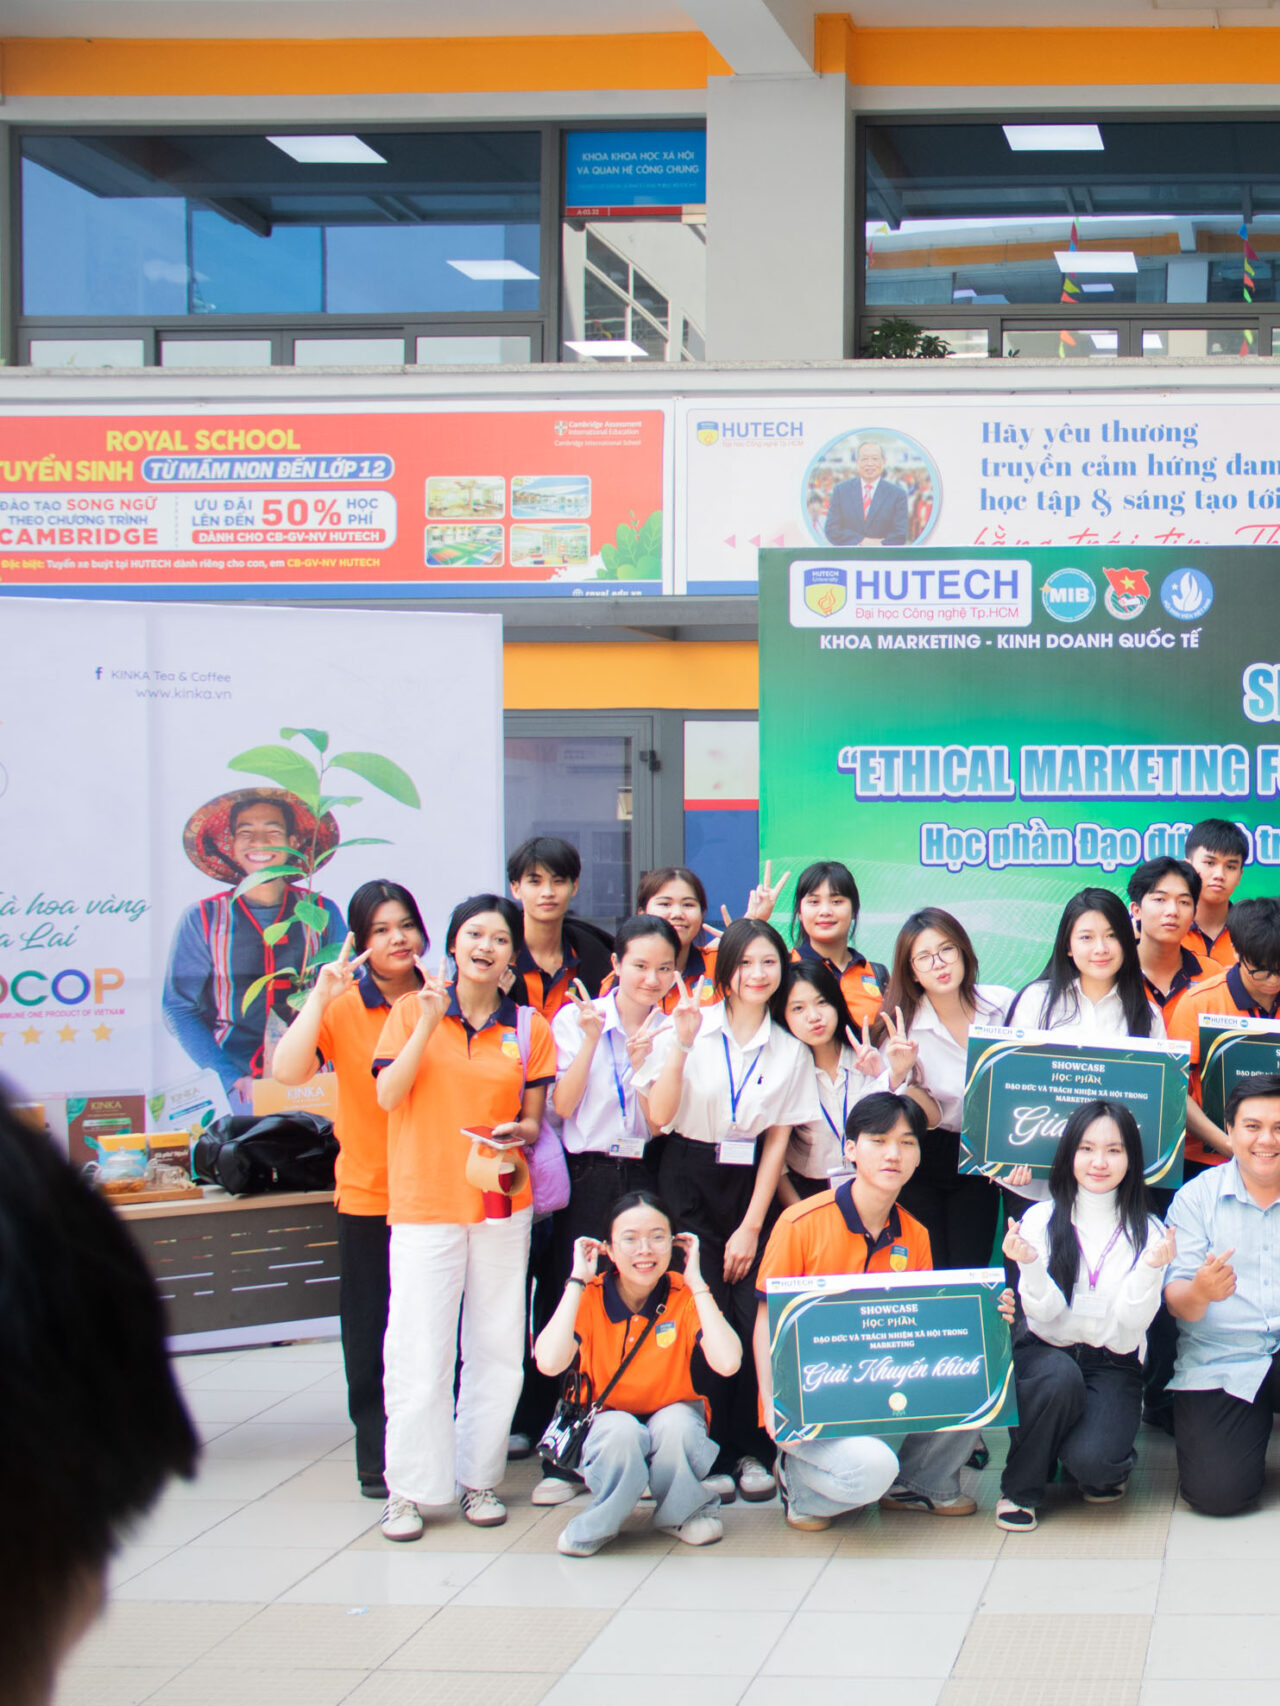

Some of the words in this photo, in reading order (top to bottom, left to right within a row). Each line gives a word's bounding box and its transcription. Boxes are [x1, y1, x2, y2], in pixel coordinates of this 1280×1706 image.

[582, 152, 608, 161] KHOA
[611, 152, 637, 161] KHOA
[722, 421, 803, 438] HUTECH
[981, 422, 1033, 449] Hãy
[1043, 423, 1092, 450] yêu
[1101, 420, 1199, 449] thương
[106, 430, 188, 451] ROYAL
[195, 429, 301, 451] SCHOOL
[76, 460, 133, 482] SINH
[150, 458, 179, 480] TỪ
[179, 458, 233, 480] MẦM
[233, 461, 276, 479] NON
[277, 457, 319, 479] ĐẾN
[319, 456, 358, 478] LỚP
[359, 460, 386, 478] 12
[981, 453, 1072, 483] truyền
[1082, 453, 1137, 477] cảm
[1148, 454, 1217, 482] hứng
[67, 498, 114, 511] SONG
[120, 495, 158, 511] NGỮ
[347, 498, 378, 513] HỌC
[979, 488, 1027, 515] học
[1036, 488, 1081, 516] tập
[1091, 488, 1112, 516] &
[1123, 488, 1186, 516] sáng
[1195, 489, 1238, 515] tạo
[9, 515, 44, 525] THEO
[108, 512, 148, 525] TRÌNH
[192, 513, 220, 526] LÊN
[262, 498, 341, 527] 50%
[348, 511, 373, 525] PHÍ
[0, 528, 158, 545] CAMBRIDGE
[199, 530, 234, 542] DÀNH
[237, 532, 263, 542] CHO
[266, 532, 327, 542] CB-GV-NV
[330, 531, 380, 541] HUTECH
[339, 558, 380, 567] HUTECH
[855, 569, 1019, 600] HUTECH
[1051, 587, 1090, 603] MIB
[855, 607, 874, 620] Đại
[877, 607, 899, 620] học
[902, 606, 934, 621] Công
[937, 607, 967, 621] nghệ
[970, 606, 1019, 620] Tp.HCM
[820, 634, 872, 649] KHOA
[877, 633, 982, 649] MARKETING
[997, 633, 1041, 648] KINH
[1046, 633, 1113, 648] DOANH
[1119, 627, 1176, 649] QUỐC
[1180, 627, 1202, 648] TẾ
[111, 670, 150, 680] KINKA
[154, 671, 175, 680] Tea
[191, 672, 231, 682] Coffee
[136, 688, 232, 700] www.kinka.vn
[1022, 747, 1248, 796] MARKETING
[924, 827, 986, 868] Học
[992, 820, 1070, 865] phần
[1078, 827, 1138, 868] Đạo
[25, 892, 79, 916] hoa
[86, 894, 152, 922] vàng
[20, 922, 80, 951] Lai
[0, 968, 125, 1006] COP
[1051, 1061, 1105, 1073] SHOWCASE
[286, 1085, 325, 1099] KINKA
[860, 1303, 918, 1316] SHOWCASE
[870, 1340, 915, 1349] MARKETING
[803, 1360, 850, 1393] Giải
[853, 1355, 928, 1389] Khuyến
[932, 1353, 984, 1378] khích
